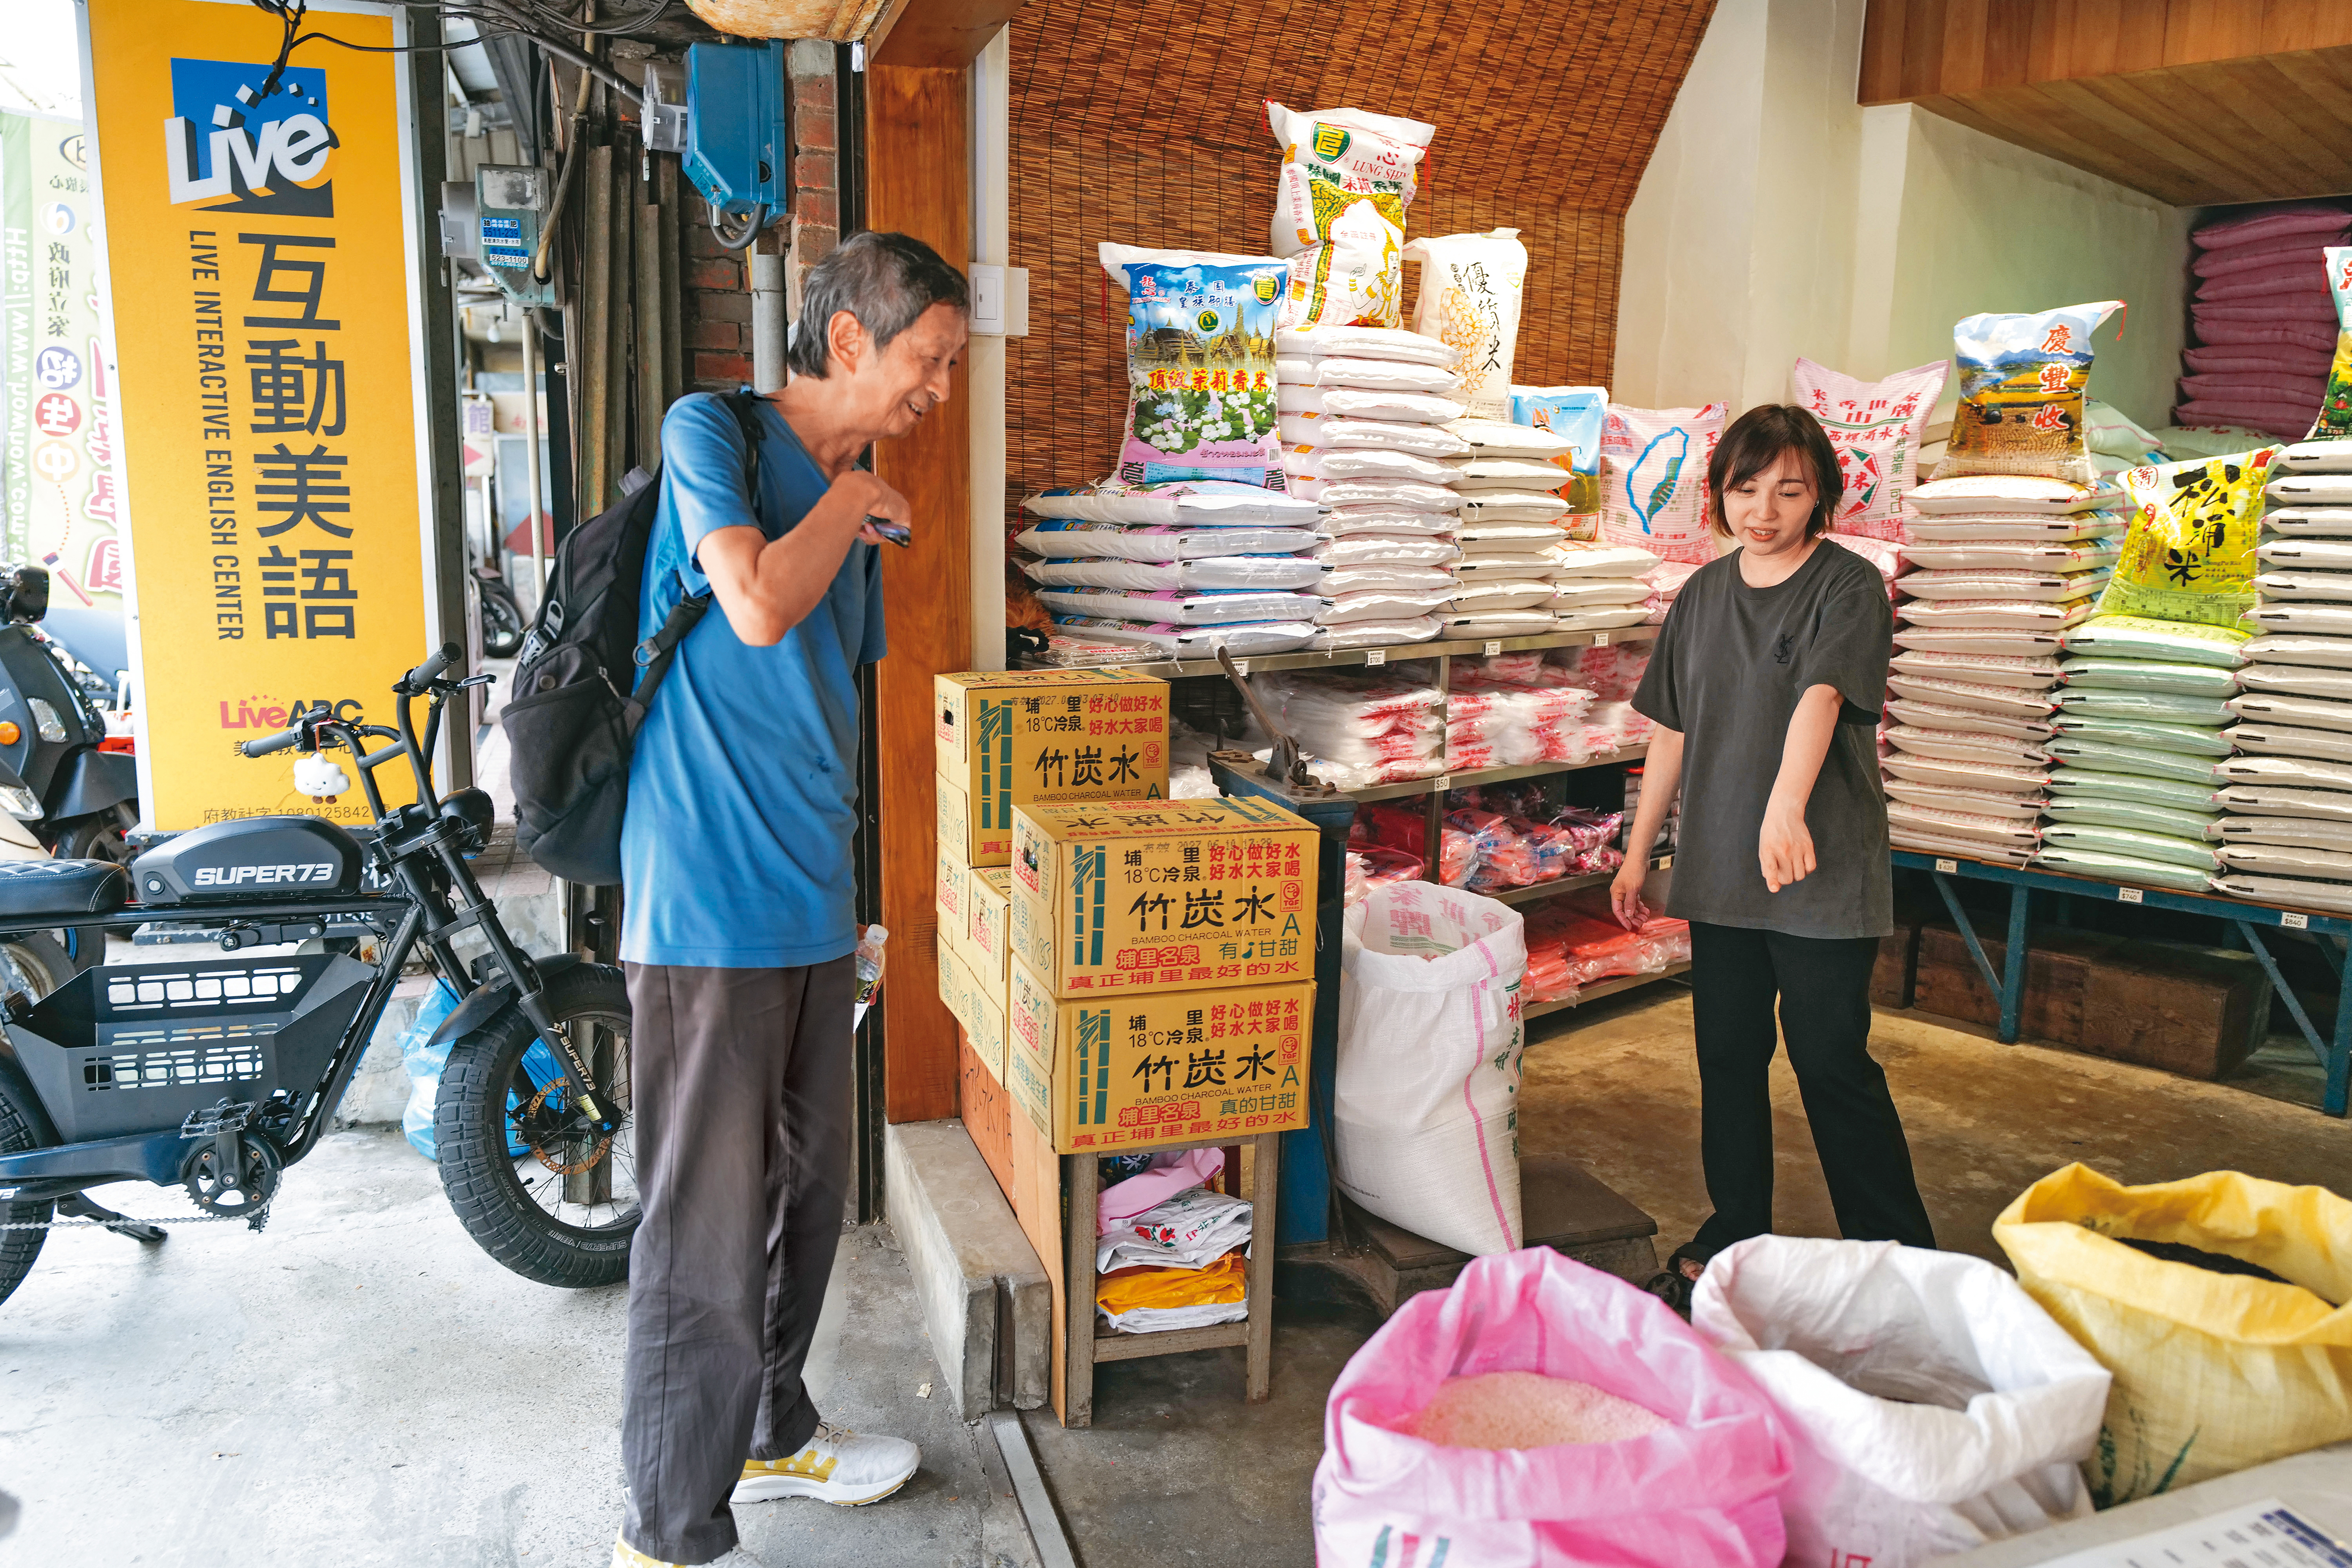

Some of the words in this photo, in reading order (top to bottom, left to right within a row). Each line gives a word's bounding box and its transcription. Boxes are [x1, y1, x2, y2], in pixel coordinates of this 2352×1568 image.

[164, 103, 330, 205] Live
[1352, 160, 1383, 176] LUNG
[484, 228, 518, 238] 5511-239
[190, 230, 219, 281] LIVE
[491, 255, 526, 264] 523-1100
[195, 291, 230, 440] INTERACTIVE
[2036, 325, 2074, 429] 慶豐收
[1148, 368, 1268, 392] 頂級茉莉香米
[238, 233, 357, 639] 互動美語
[1821, 424, 1910, 442] 西螺濁水米
[206, 449, 237, 545] ENGLISH
[213, 555, 243, 640] CENTER
[1025, 696, 1081, 714] 埔里
[1089, 696, 1162, 714] 好心做好水
[1089, 717, 1162, 736] 好水大家喝
[1034, 745, 1140, 788] 竹炭水
[1069, 792, 1111, 800] CHARCOAL
[1113, 789, 1141, 798] WATER
[1146, 783, 1162, 800] A
[1436, 778, 1448, 789] $50
[1066, 813, 1225, 829] 竹炭水
[1124, 847, 1201, 867] 埔里
[1210, 842, 1301, 862] 好心做好水
[195, 863, 334, 886] SUPER73
[1210, 860, 1301, 881] 好水大家喝
[1128, 886, 1276, 932] 竹炭水
[1132, 935, 1175, 945] BAMBOO
[1178, 931, 1234, 942] CHARCOAL
[1235, 928, 1272, 938] WATER
[1281, 913, 1301, 936] A
[1116, 945, 1200, 970] 埔里名泉
[1068, 961, 1300, 989] 真正埔里最好的水
[1129, 1009, 1203, 1031] 埔里
[1210, 998, 1299, 1022] 好心做好水
[1210, 1015, 1299, 1039] 好水大家喝
[560, 1035, 596, 1091] SUPER73
[1132, 1044, 1276, 1093] 竹炭水
[1280, 1065, 1300, 1088] A
[1135, 1095, 1178, 1106] BAMBOO
[1181, 1089, 1234, 1100] CHARCOAL
[1237, 1083, 1272, 1094] WATER
[1118, 1101, 1201, 1127] 埔里名泉
[1218, 1092, 1296, 1116] 真的甘甜
[1071, 1111, 1296, 1149] 真正埔里最好的水
